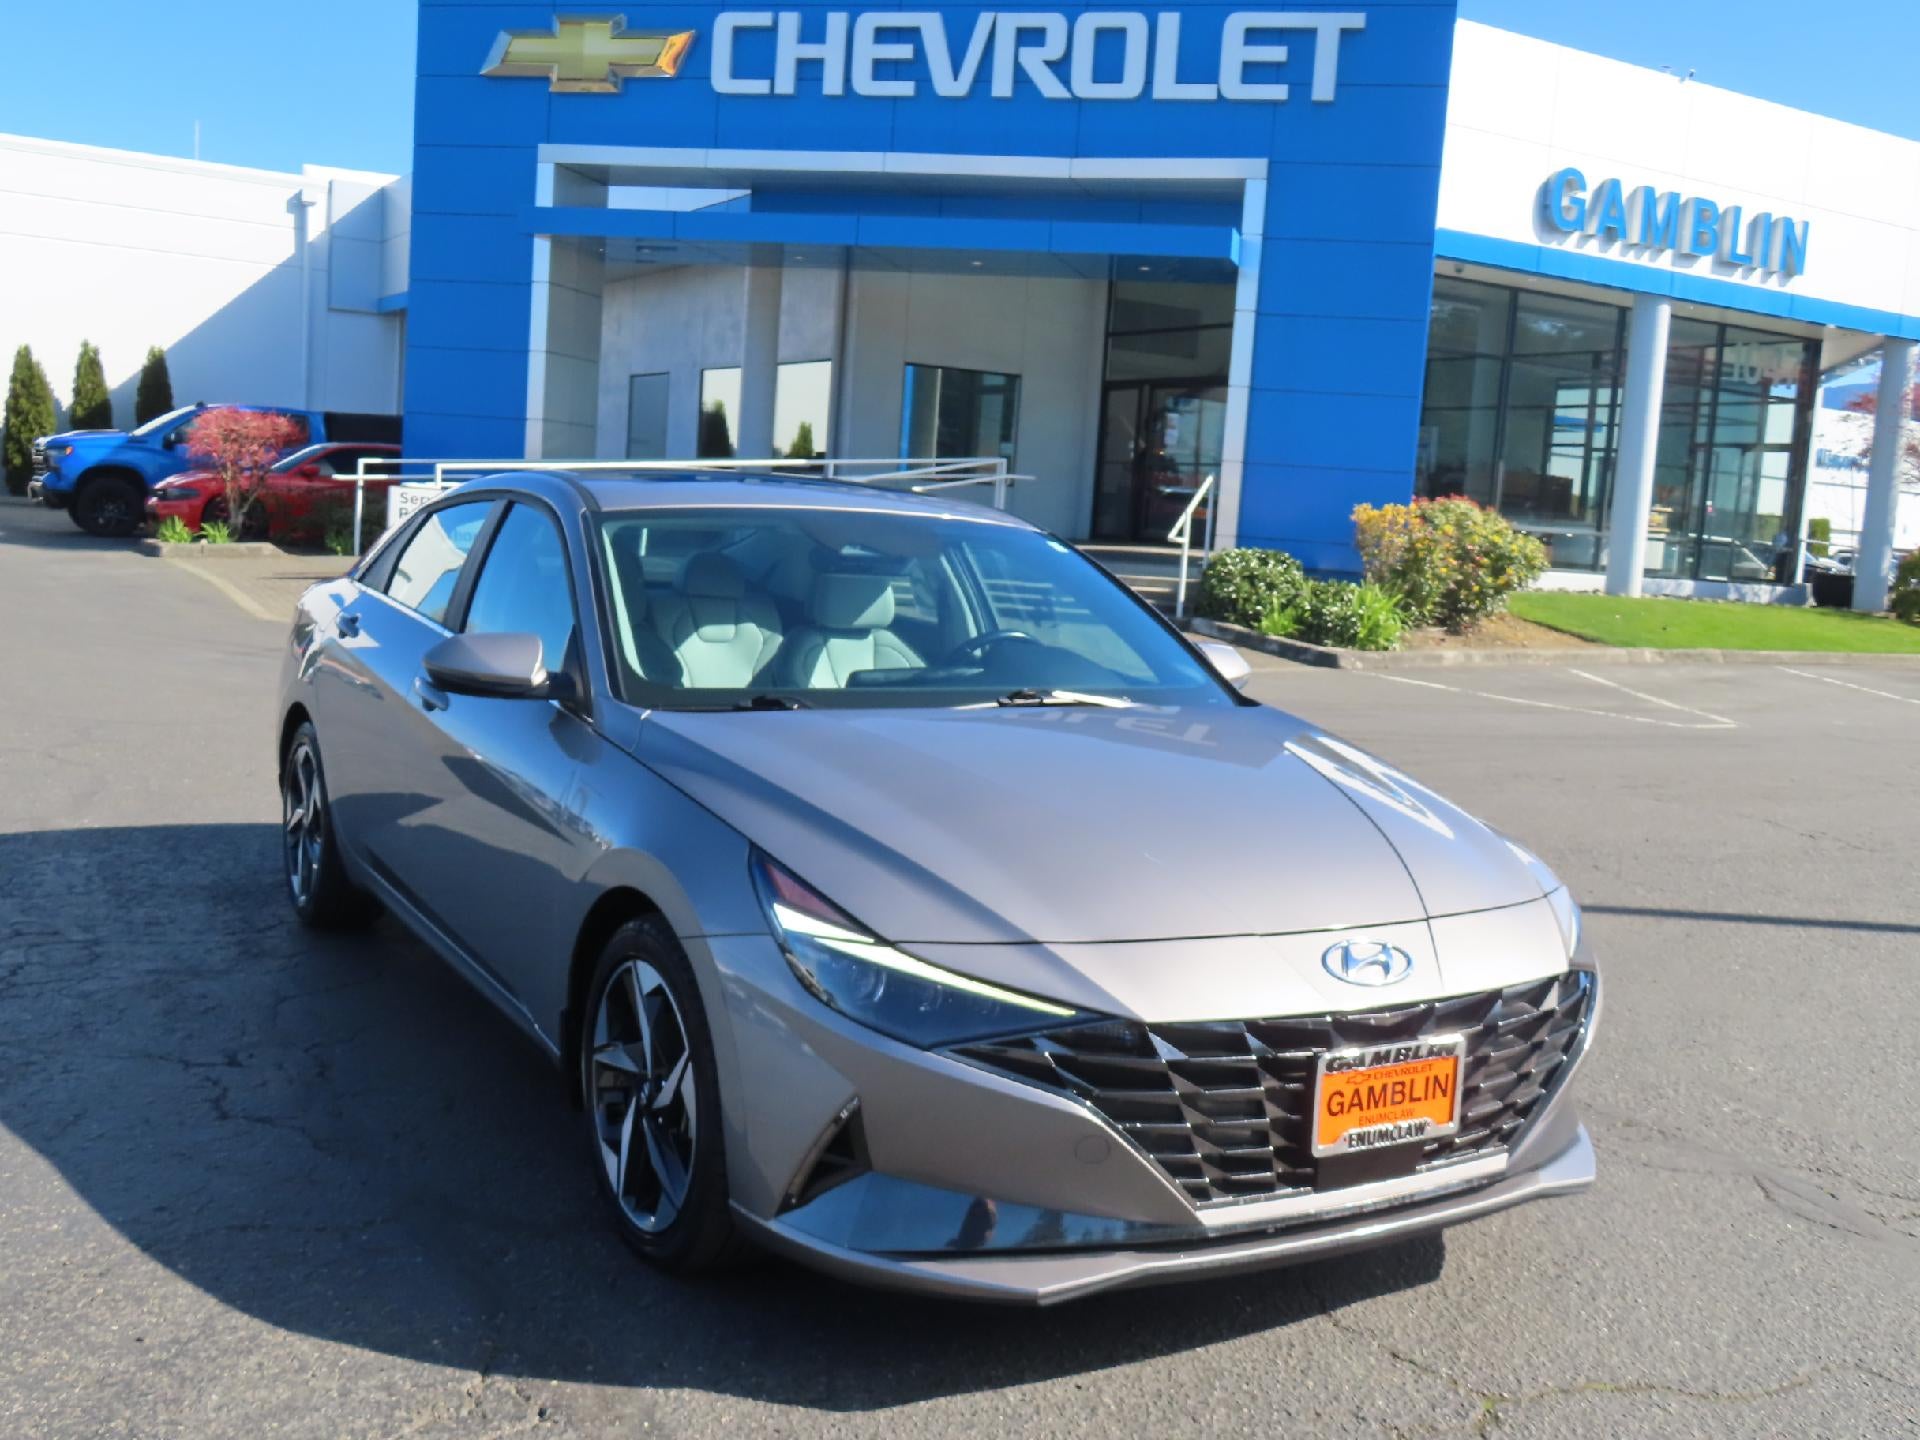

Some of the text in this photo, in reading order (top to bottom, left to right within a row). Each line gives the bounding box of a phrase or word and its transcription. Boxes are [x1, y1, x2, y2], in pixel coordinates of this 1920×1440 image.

[710, 10, 1366, 102] CHEVROLET
[1535, 167, 1809, 276] GAMBLIN
[1373, 1063, 1434, 1081] CHEVROLET
[1327, 1073, 1450, 1117] GAMBLIN
[1347, 1119, 1427, 1148] ENUMCLAW
[1358, 1107, 1416, 1125] ENUMCLAW
